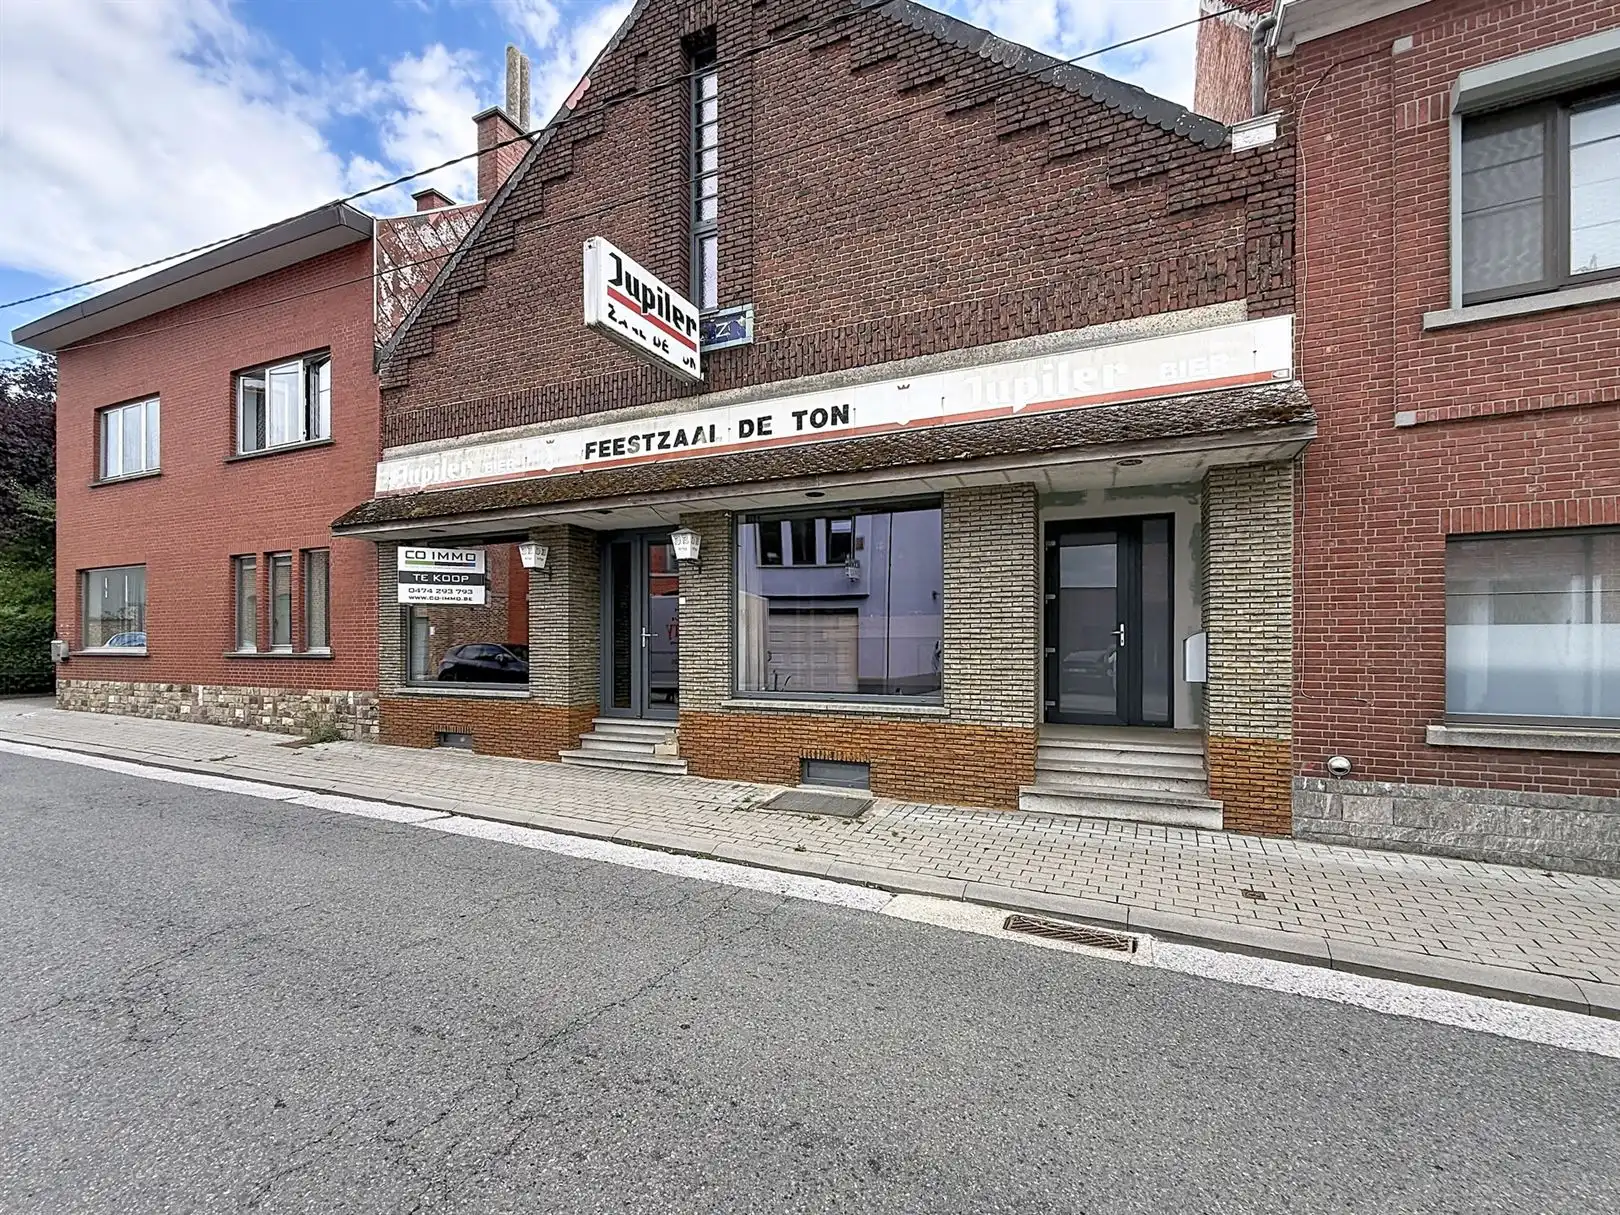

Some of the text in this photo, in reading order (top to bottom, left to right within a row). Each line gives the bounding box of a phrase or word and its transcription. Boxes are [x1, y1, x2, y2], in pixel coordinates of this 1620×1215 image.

[607, 252, 697, 336] Jupiler
[964, 353, 1230, 413] Jupiler BIER
[738, 415, 773, 439] DE
[792, 404, 850, 431] TON
[405, 550, 476, 561] CO IMMO
[412, 573, 469, 583] TE KOOP
